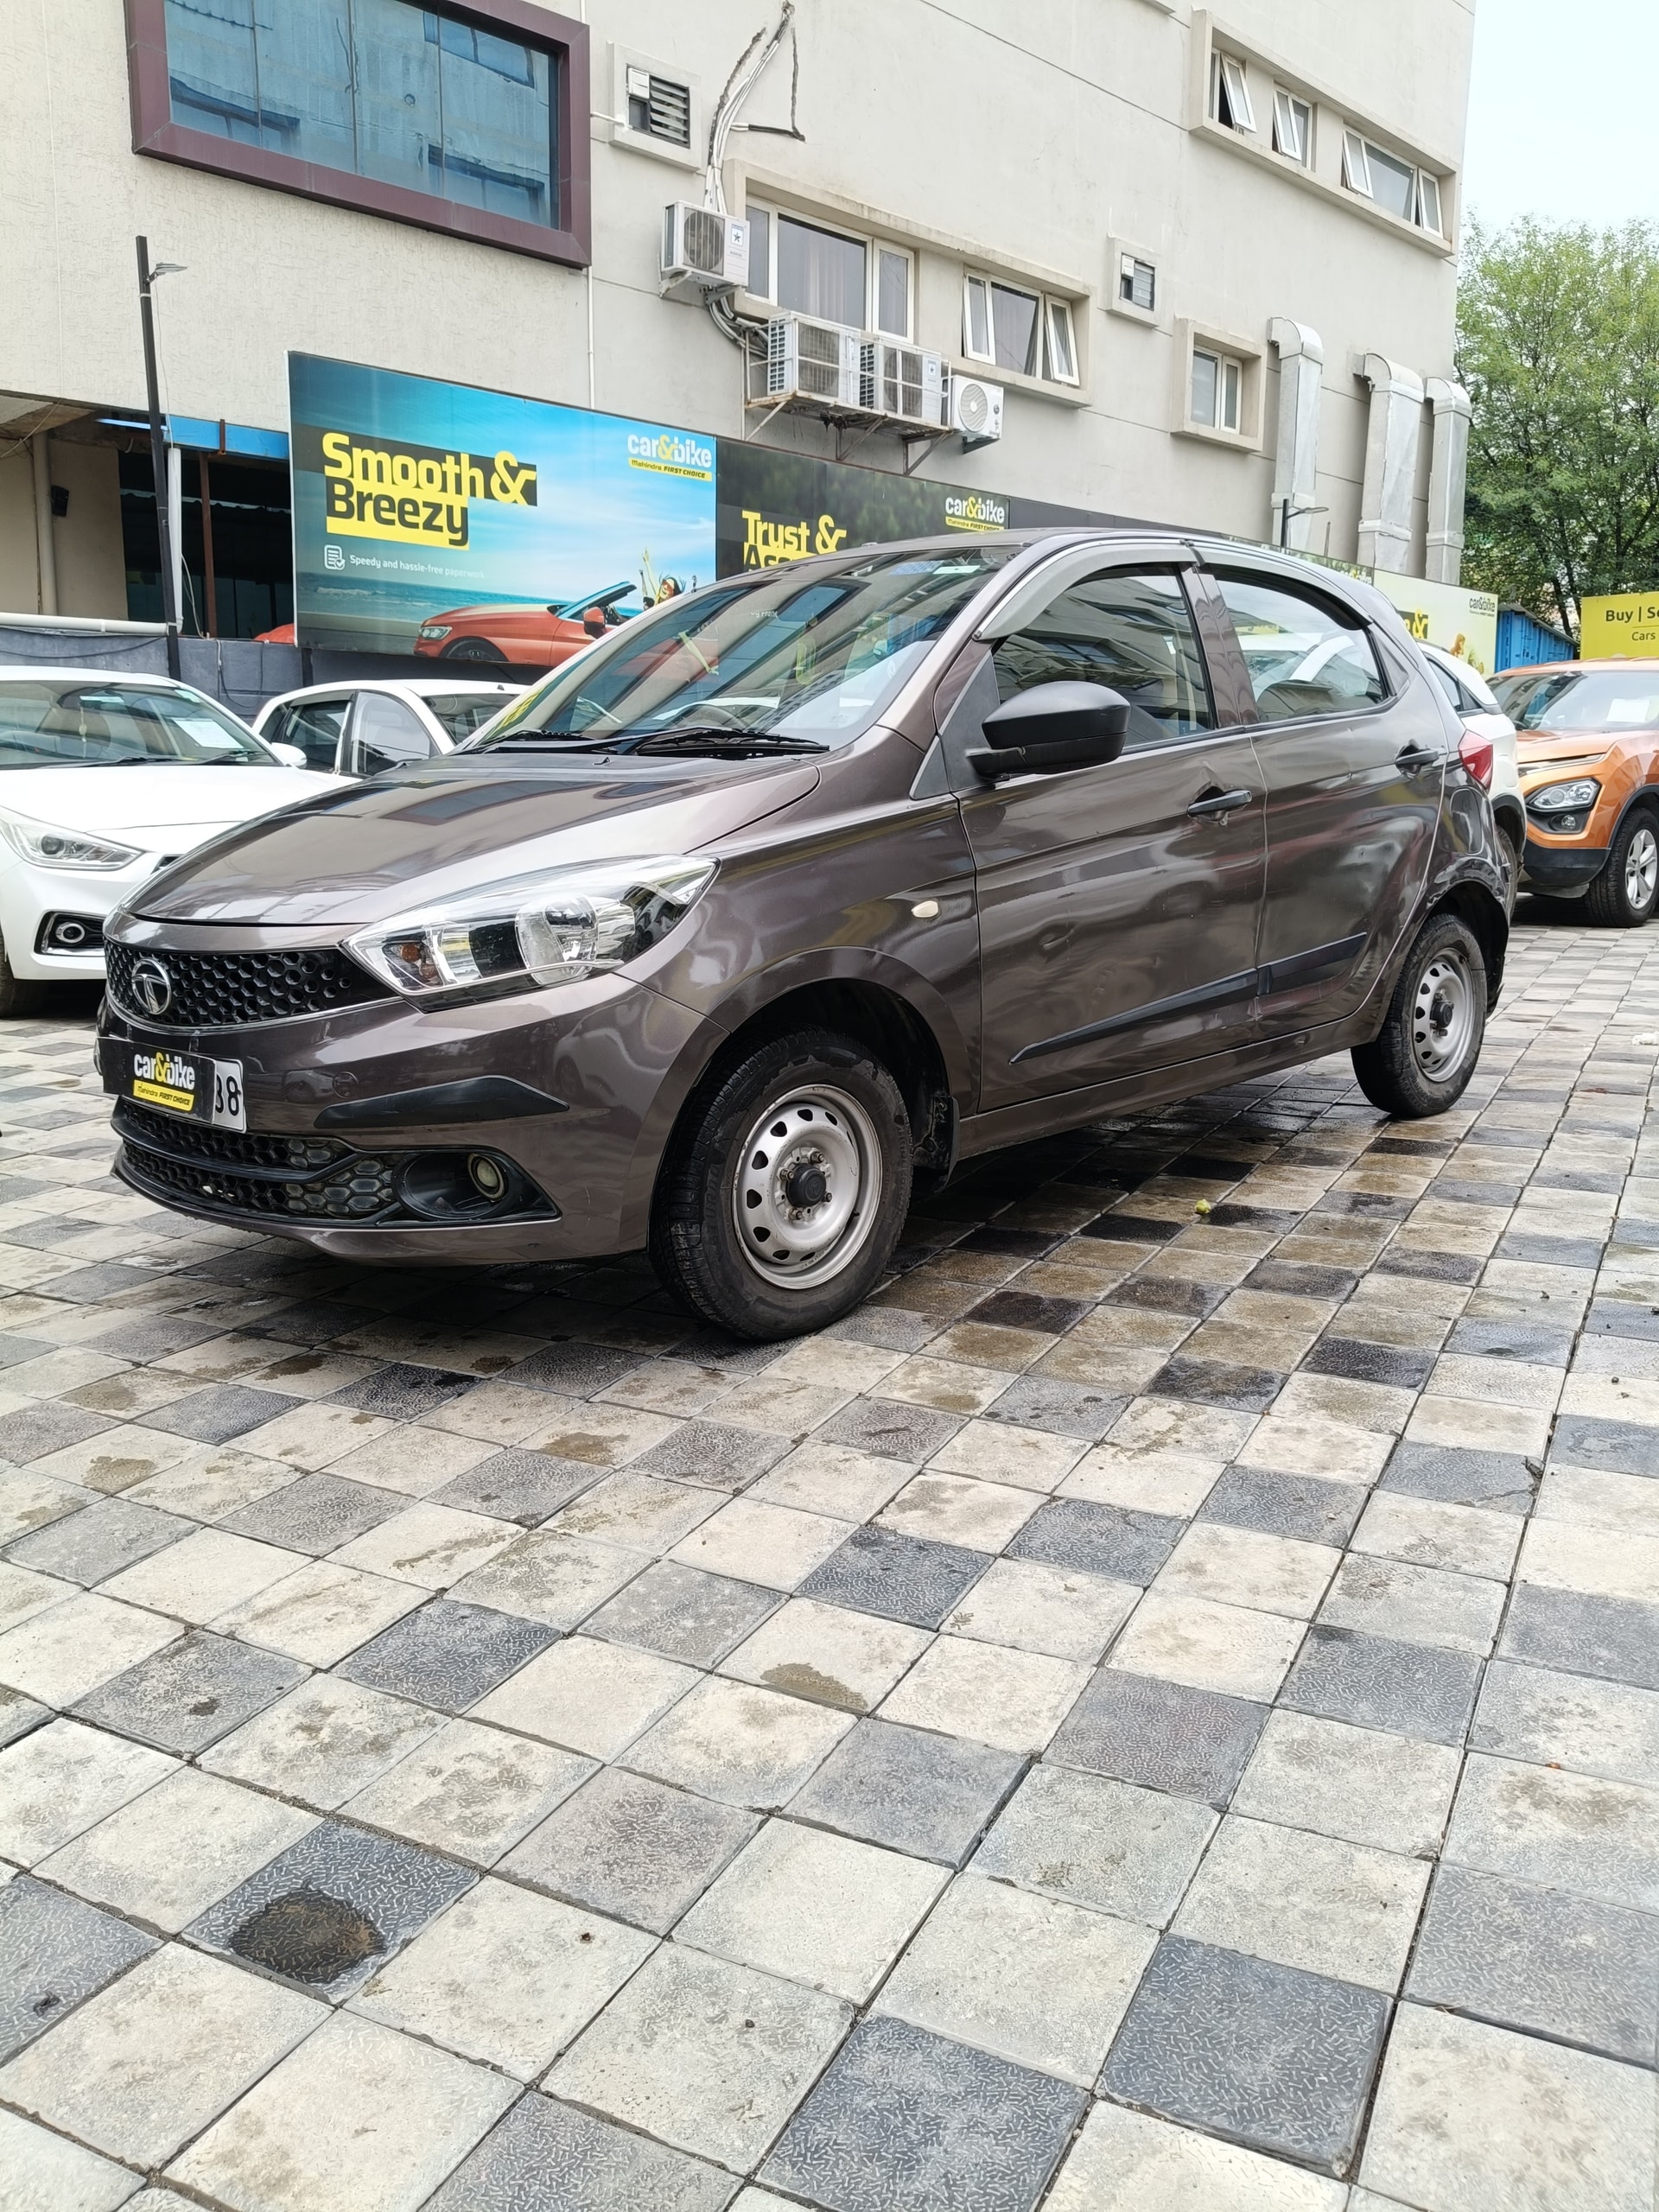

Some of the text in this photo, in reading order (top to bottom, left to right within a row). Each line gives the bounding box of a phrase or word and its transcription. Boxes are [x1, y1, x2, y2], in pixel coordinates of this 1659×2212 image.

[627, 435, 712, 468] car&bike
[322, 432, 537, 505] Smooth &
[631, 460, 706, 479] Mahindra FIRST CHOICE
[326, 478, 468, 547] Breezy
[945, 496, 1005, 524] car&bike
[742, 510, 847, 554] Trust &
[350, 555, 485, 579] Speedy and hassle-free paperwork
[1605, 610, 1633, 623] Buy
[1631, 632, 1656, 641] Cars
[134, 1052, 195, 1090] car&bike
